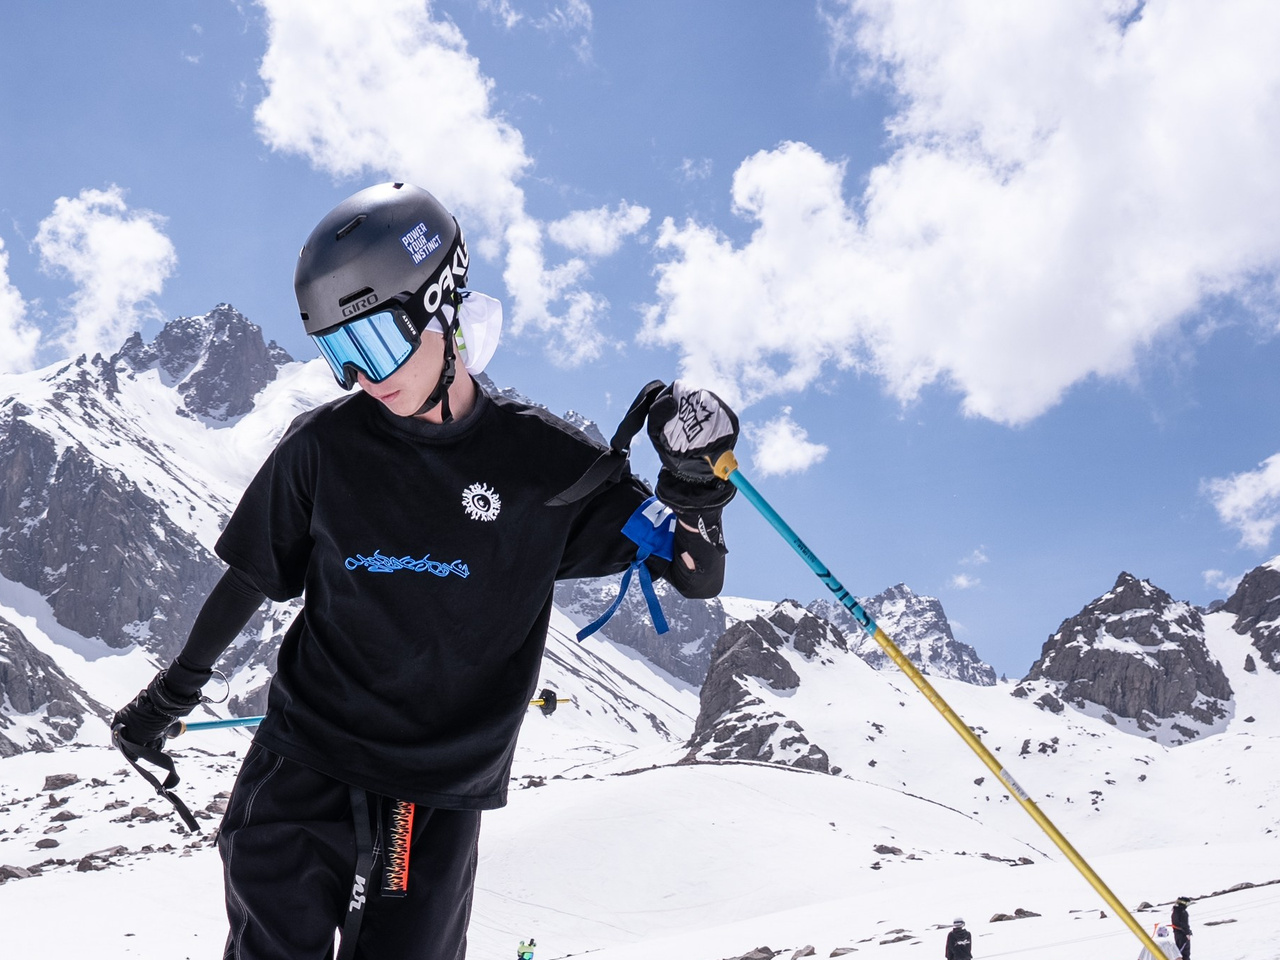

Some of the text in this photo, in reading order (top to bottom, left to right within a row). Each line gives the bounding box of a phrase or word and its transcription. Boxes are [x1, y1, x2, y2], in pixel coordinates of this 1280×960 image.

[402, 223, 427, 247] POWER
[407, 235, 427, 254] YOUR
[412, 235, 442, 264] INSTINCT
[342, 293, 378, 317] GIRO
